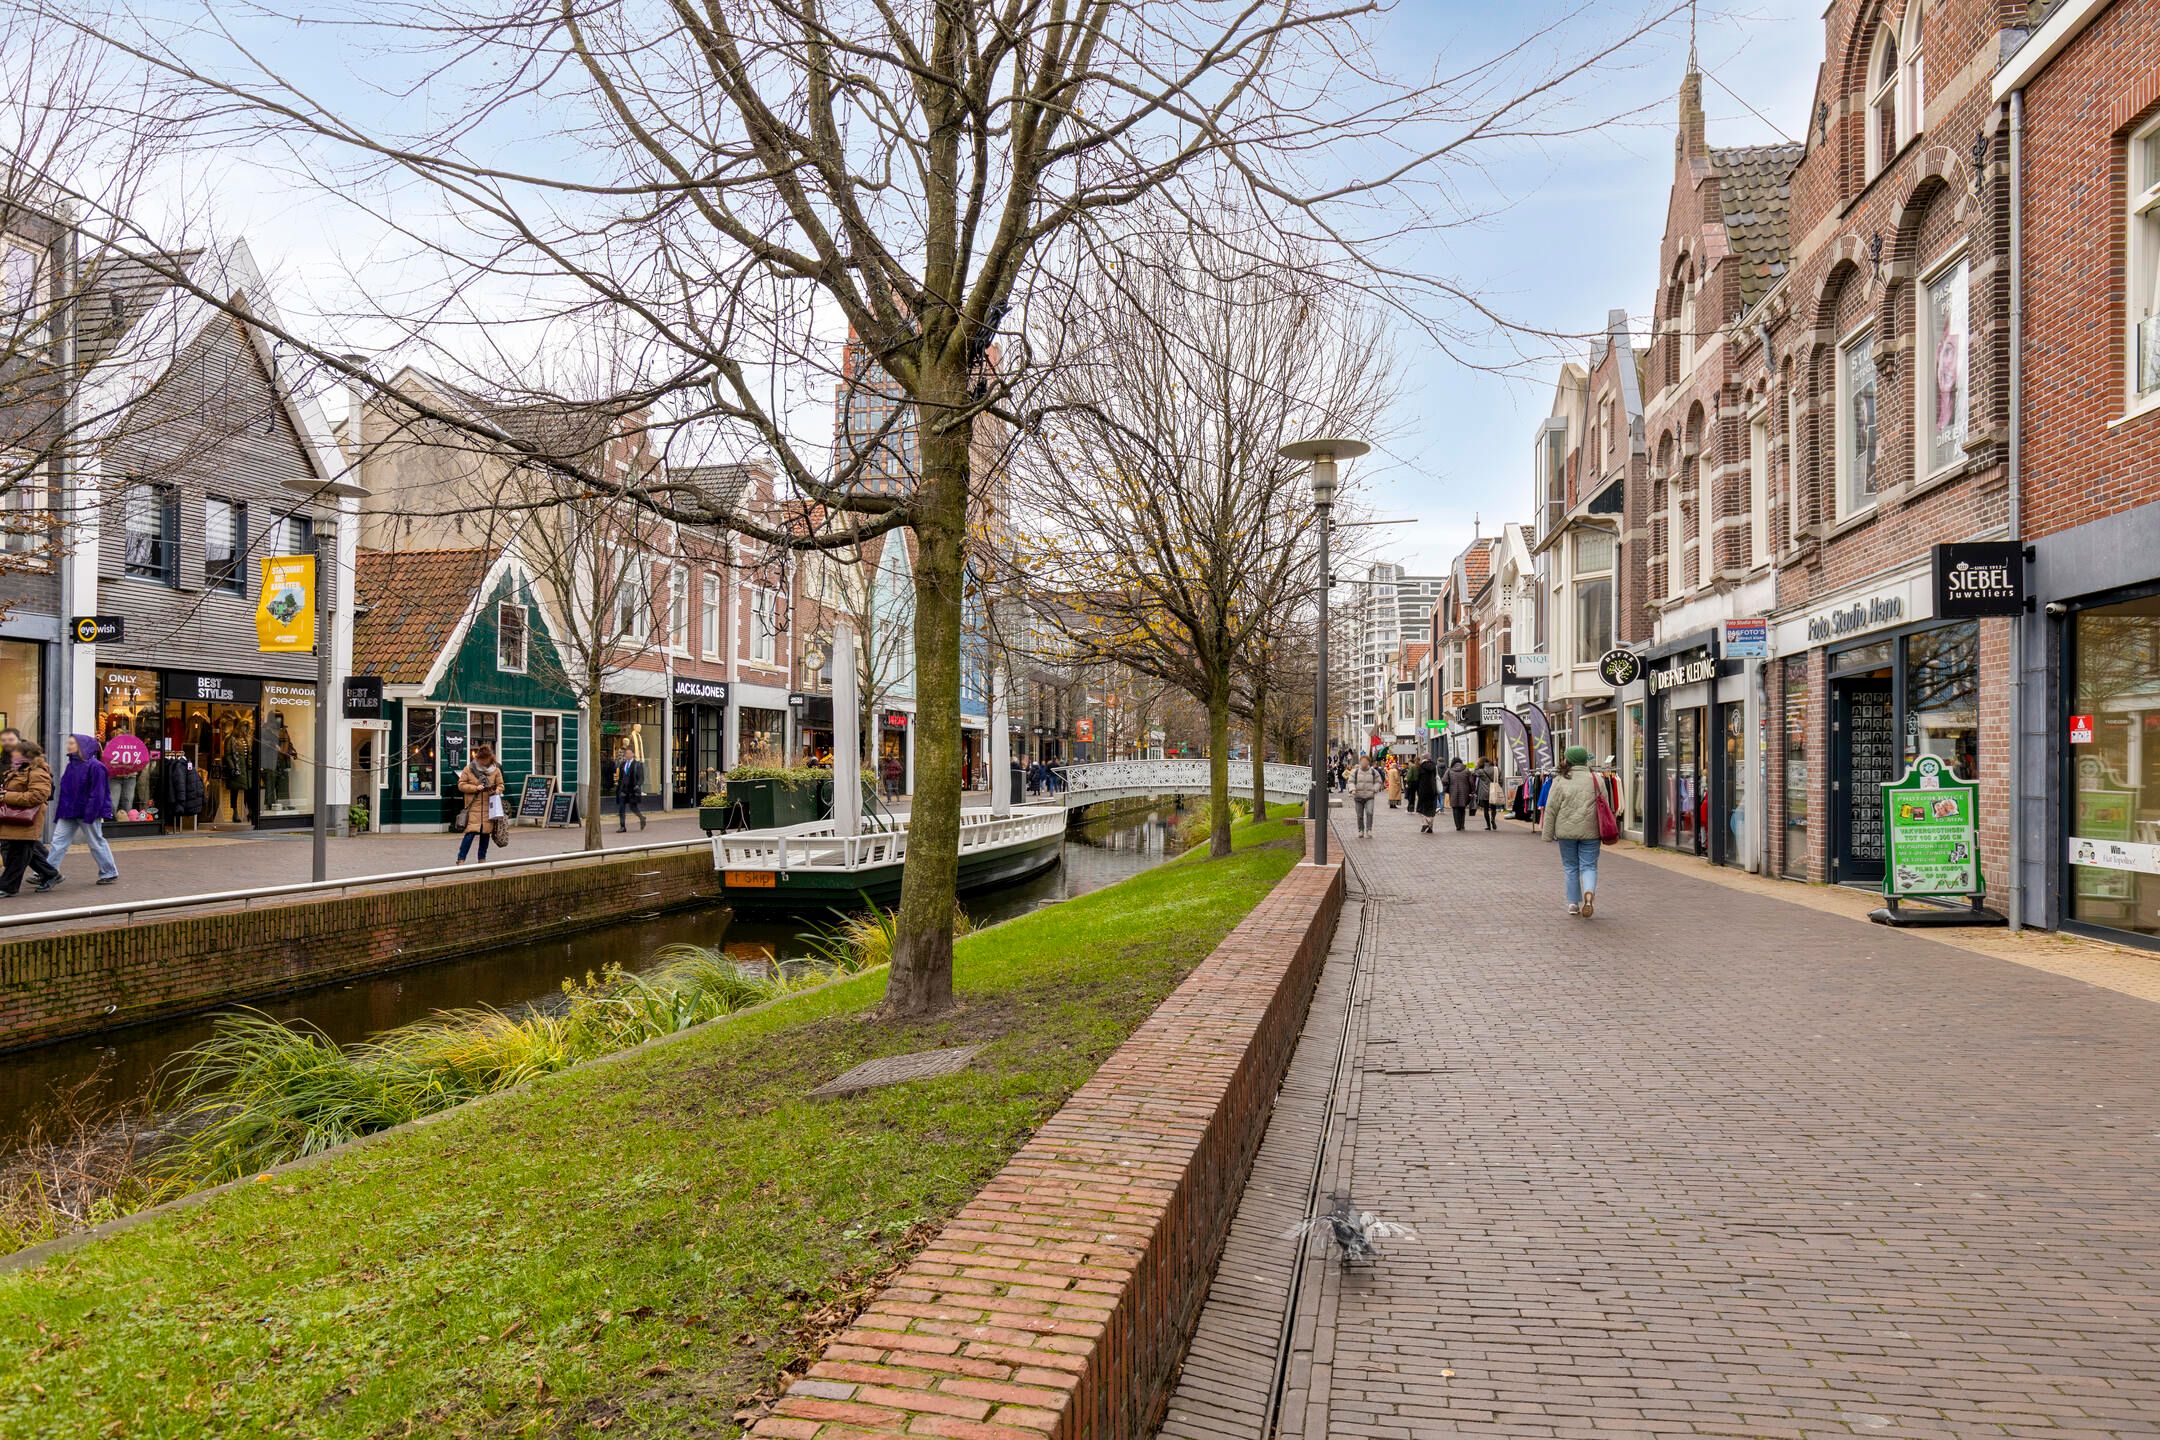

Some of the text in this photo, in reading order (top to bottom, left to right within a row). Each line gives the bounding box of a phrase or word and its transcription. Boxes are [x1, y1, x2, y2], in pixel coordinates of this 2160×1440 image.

[1948, 569, 2014, 591] SIEBEL
[1807, 595, 1904, 641] Foto Studio Heno
[1604, 652, 1635, 663] DEFNE
[108, 673, 137, 684] ONLY
[1657, 657, 1716, 690] DEFNE KLEDING
[197, 676, 223, 689] BEST
[104, 685, 142, 697] VILA
[197, 687, 235, 700] STYLES
[264, 685, 316, 697] VERO MODA
[346, 687, 369, 698] BEST
[675, 681, 725, 699] JACK&JONES
[346, 697, 379, 708] STYLES
[110, 750, 142, 765] 20%
